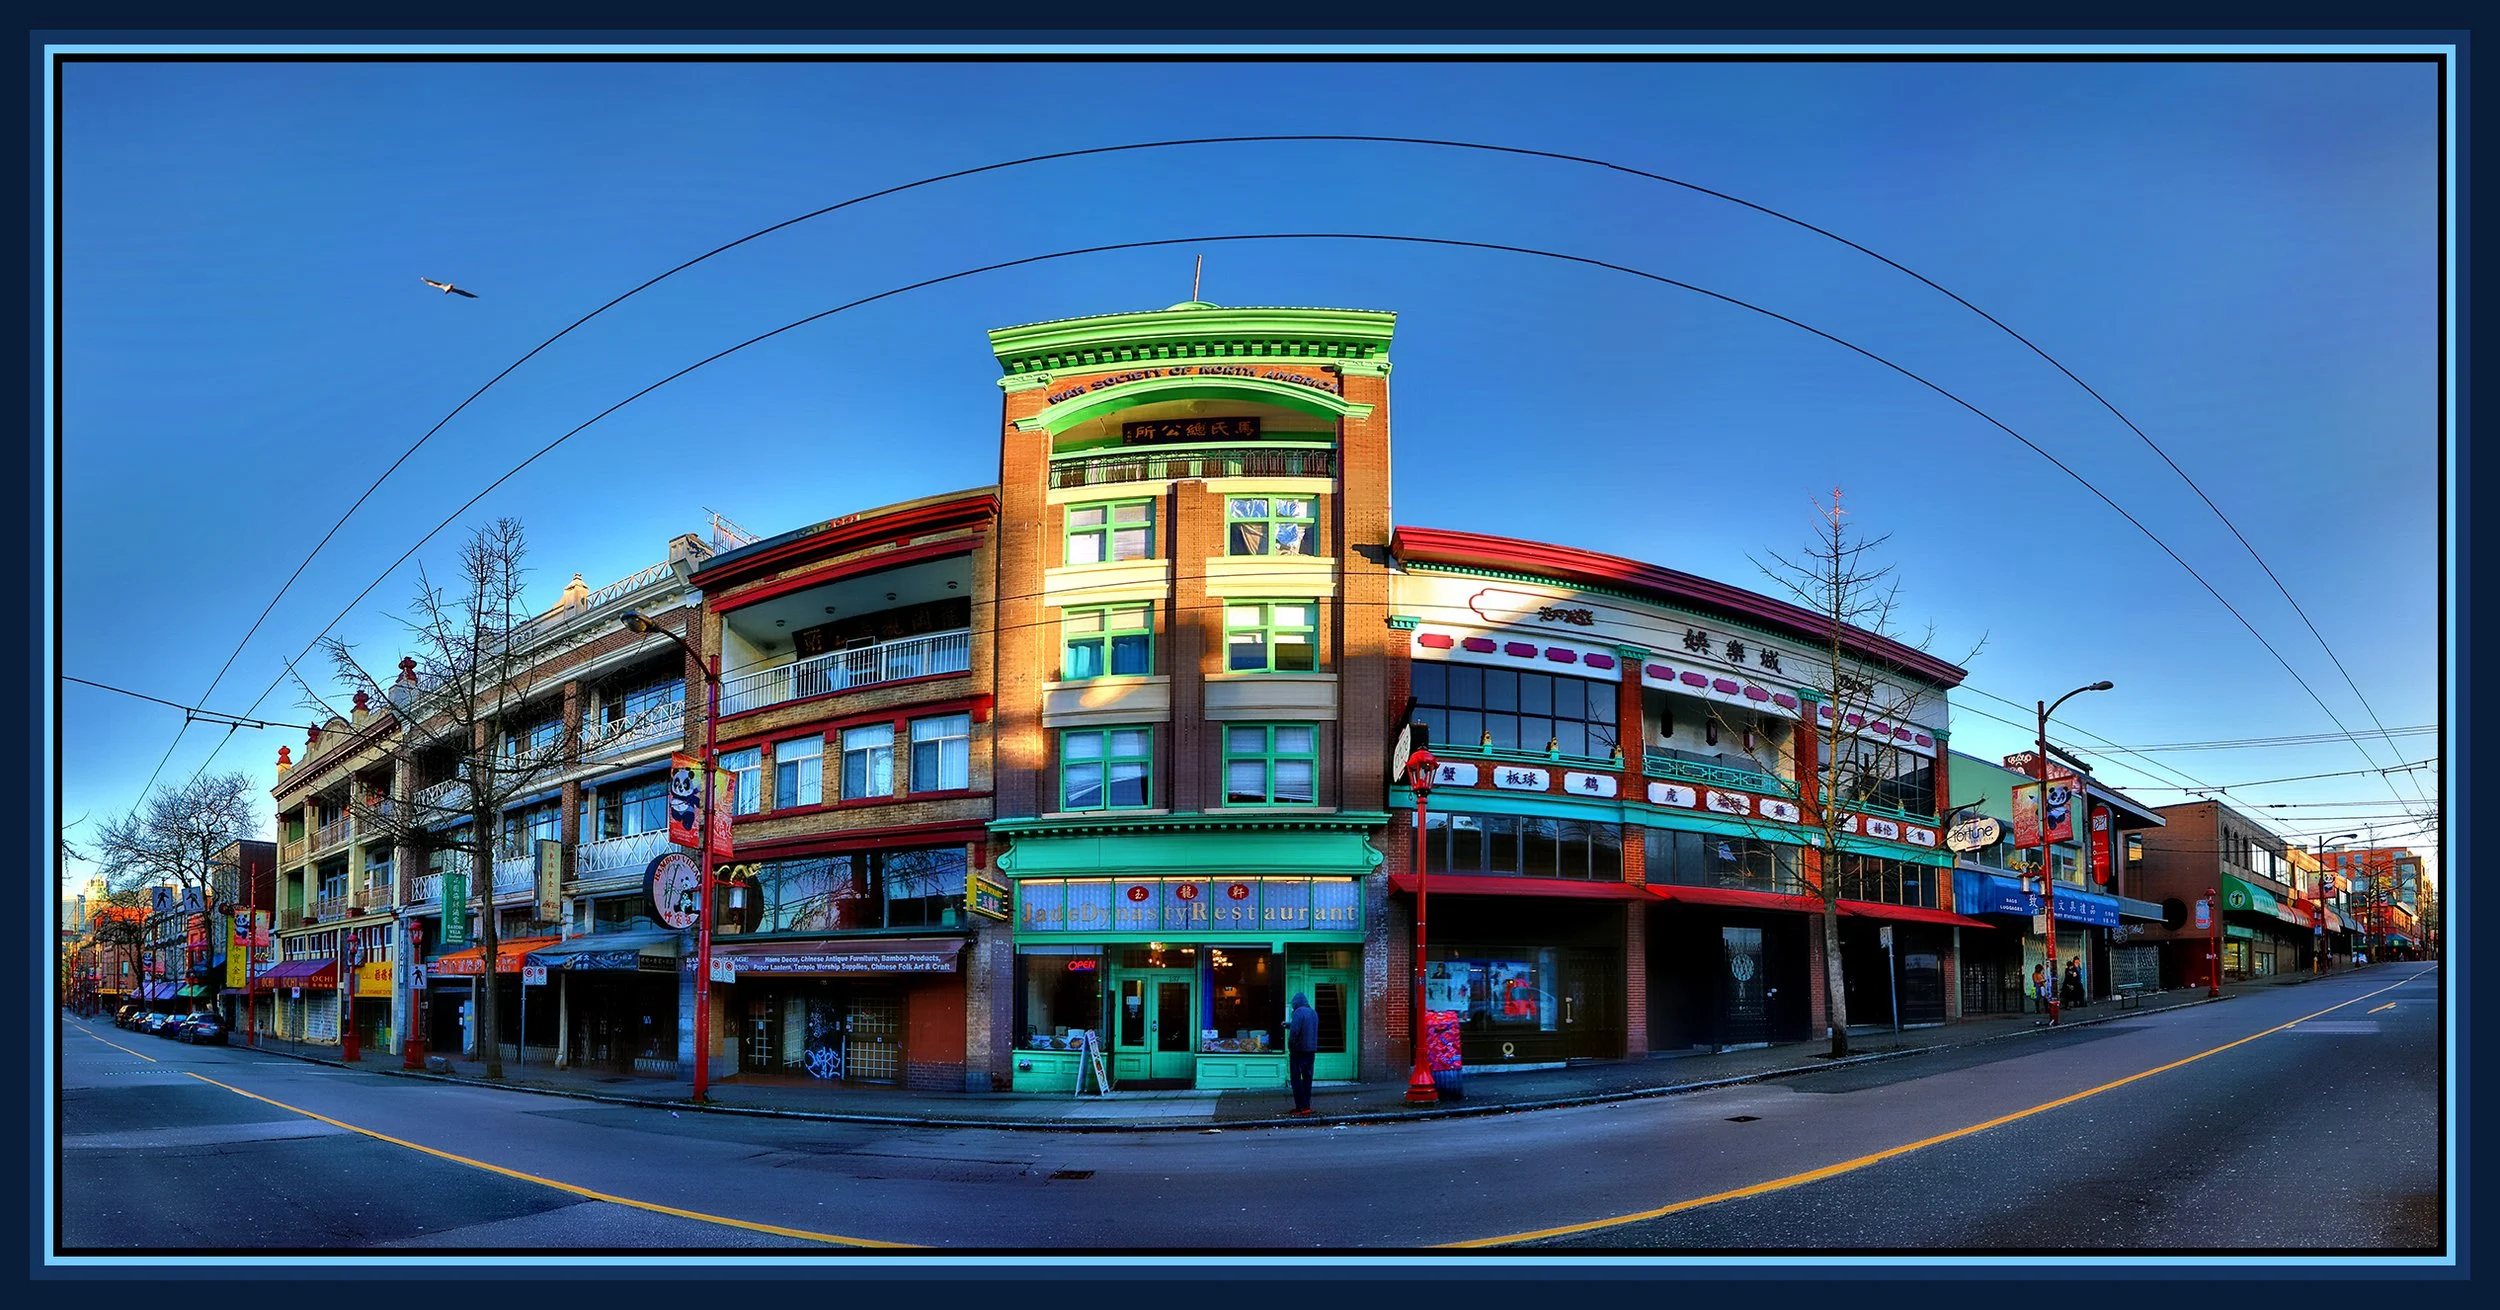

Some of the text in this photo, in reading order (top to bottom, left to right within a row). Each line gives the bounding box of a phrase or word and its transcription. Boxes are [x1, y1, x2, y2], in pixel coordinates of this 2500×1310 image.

[1048, 365, 1340, 405] MAH SOCIETY OF NORTH AMERICA
[1506, 769, 1538, 787] 板球
[1665, 787, 1678, 803] 虎
[1953, 826, 1993, 842] fortune
[654, 855, 680, 881] BAMBOO
[801, 955, 825, 963] Chinese
[825, 955, 848, 963] Antique
[849, 955, 880, 963] Furniture,
[909, 954, 941, 963] Products,
[816, 963, 841, 971] Worship
[842, 963, 870, 971] Supplies,
[932, 962, 950, 970] Craft
[1068, 960, 1096, 971] OPEN
